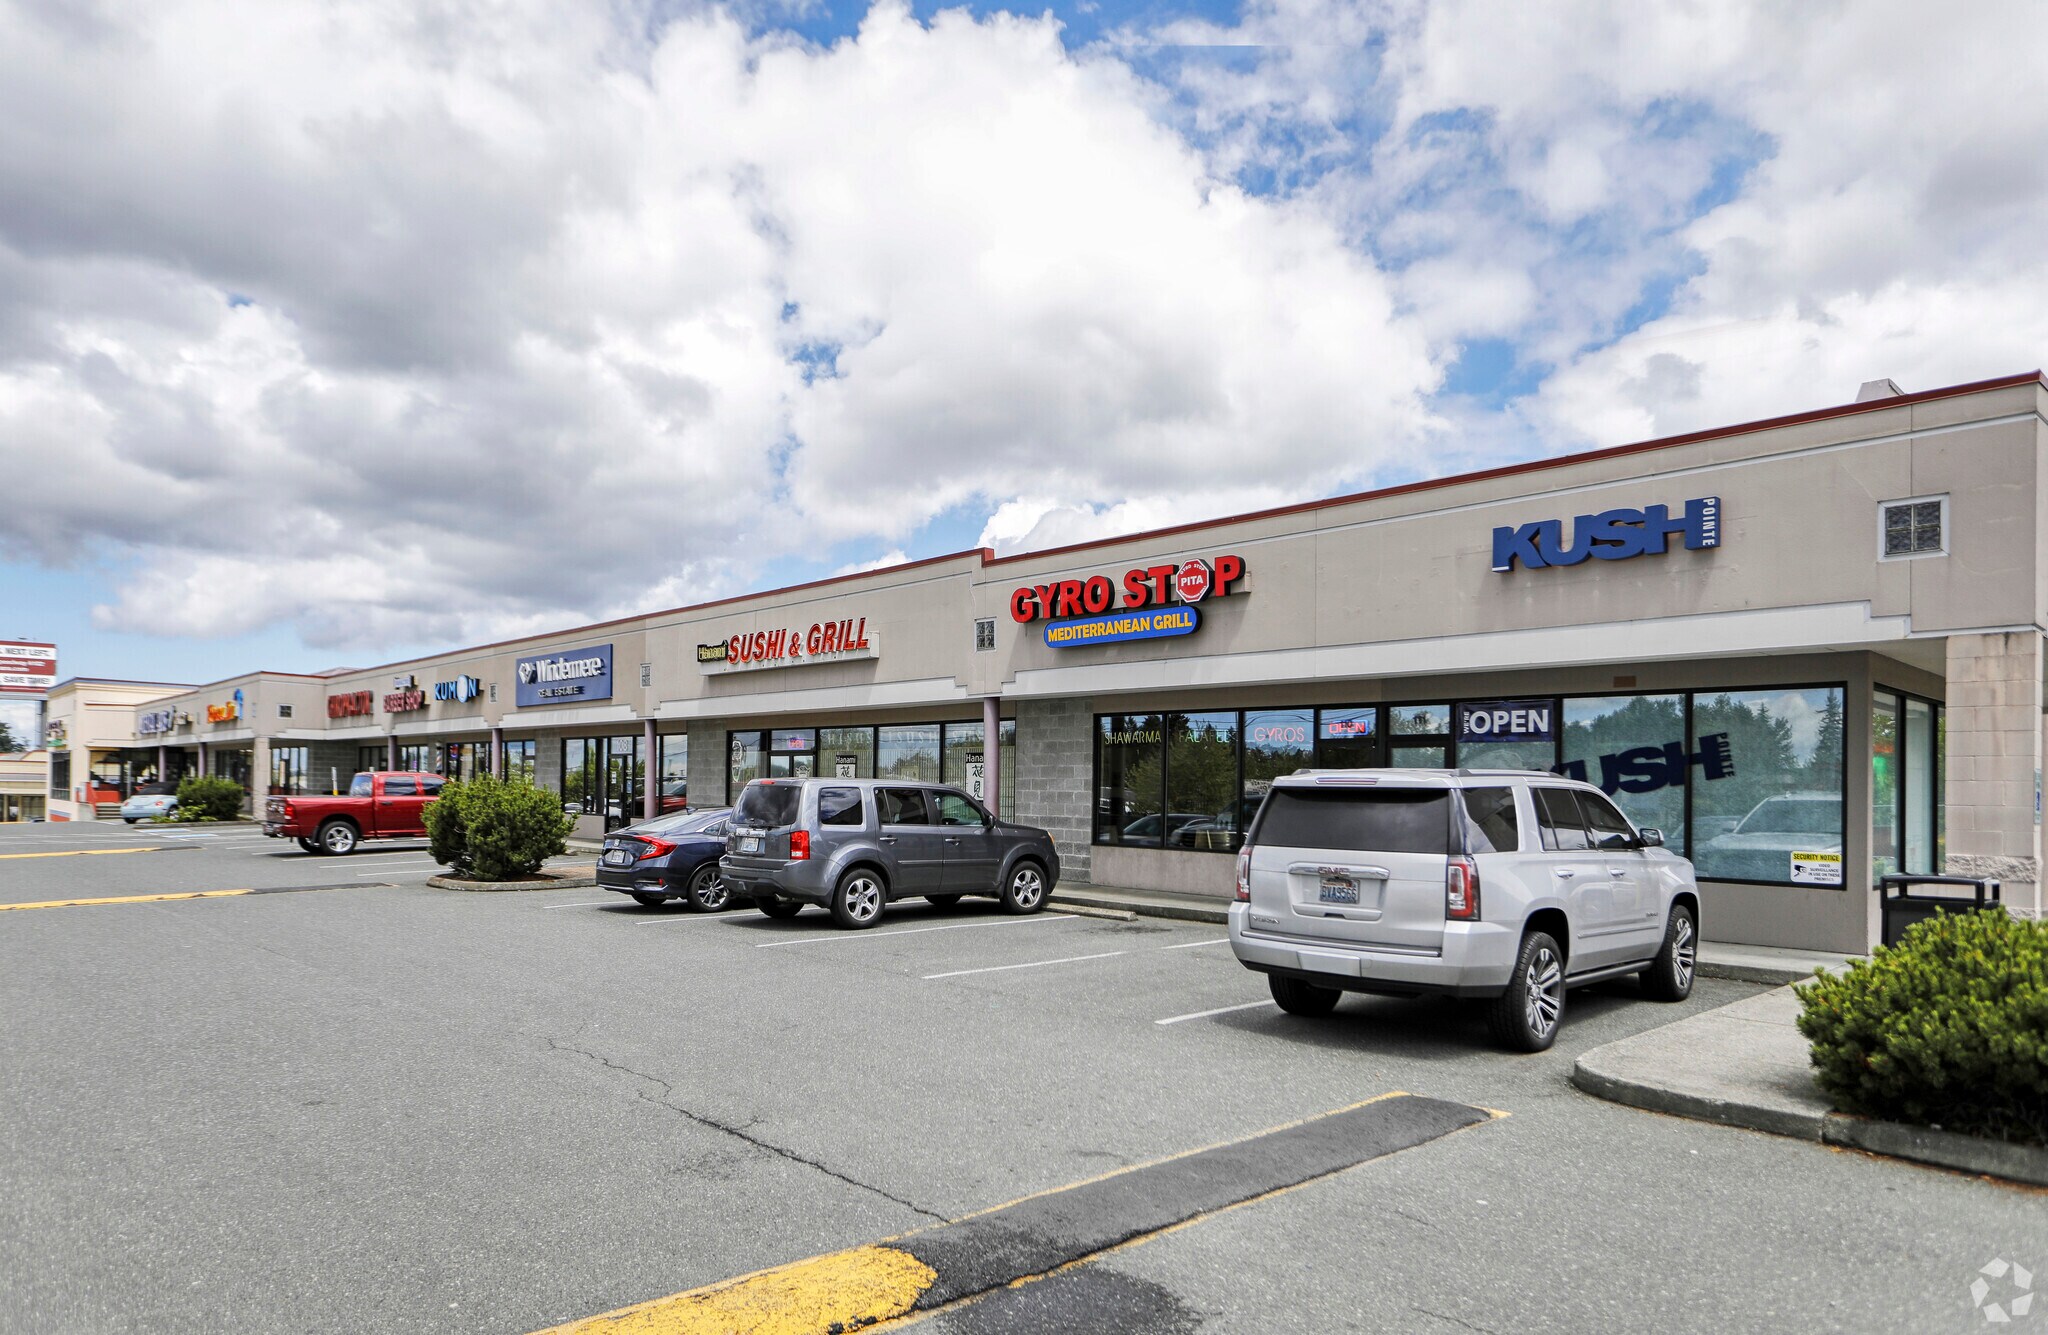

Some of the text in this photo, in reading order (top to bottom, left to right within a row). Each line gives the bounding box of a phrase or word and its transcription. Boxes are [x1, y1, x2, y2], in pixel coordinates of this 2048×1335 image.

[1702, 498, 1715, 546] POINTE
[1492, 499, 1720, 572] KUSH
[1010, 555, 1243, 623] GYRO STOP
[1180, 574, 1204, 587] PITA
[1047, 613, 1193, 642] MEDITERRANEAN GRILL
[728, 629, 787, 664] SUSHI
[788, 632, 801, 657] &
[807, 618, 869, 655] GRILL
[536, 658, 602, 682] Windermere
[435, 674, 478, 703] KUMON
[554, 685, 580, 696] ESTATE
[1329, 721, 1366, 733] OPEN
[1469, 709, 1549, 734] OPEN
[1104, 731, 1161, 745] SHAWARMA
[1254, 727, 1304, 742] GYROS
[836, 755, 856, 764] Hanami
[966, 754, 984, 764] Hana
[1550, 733, 1727, 797] USH
[1820, 854, 1840, 862] NOTICE
[1318, 866, 1350, 874] GMC
